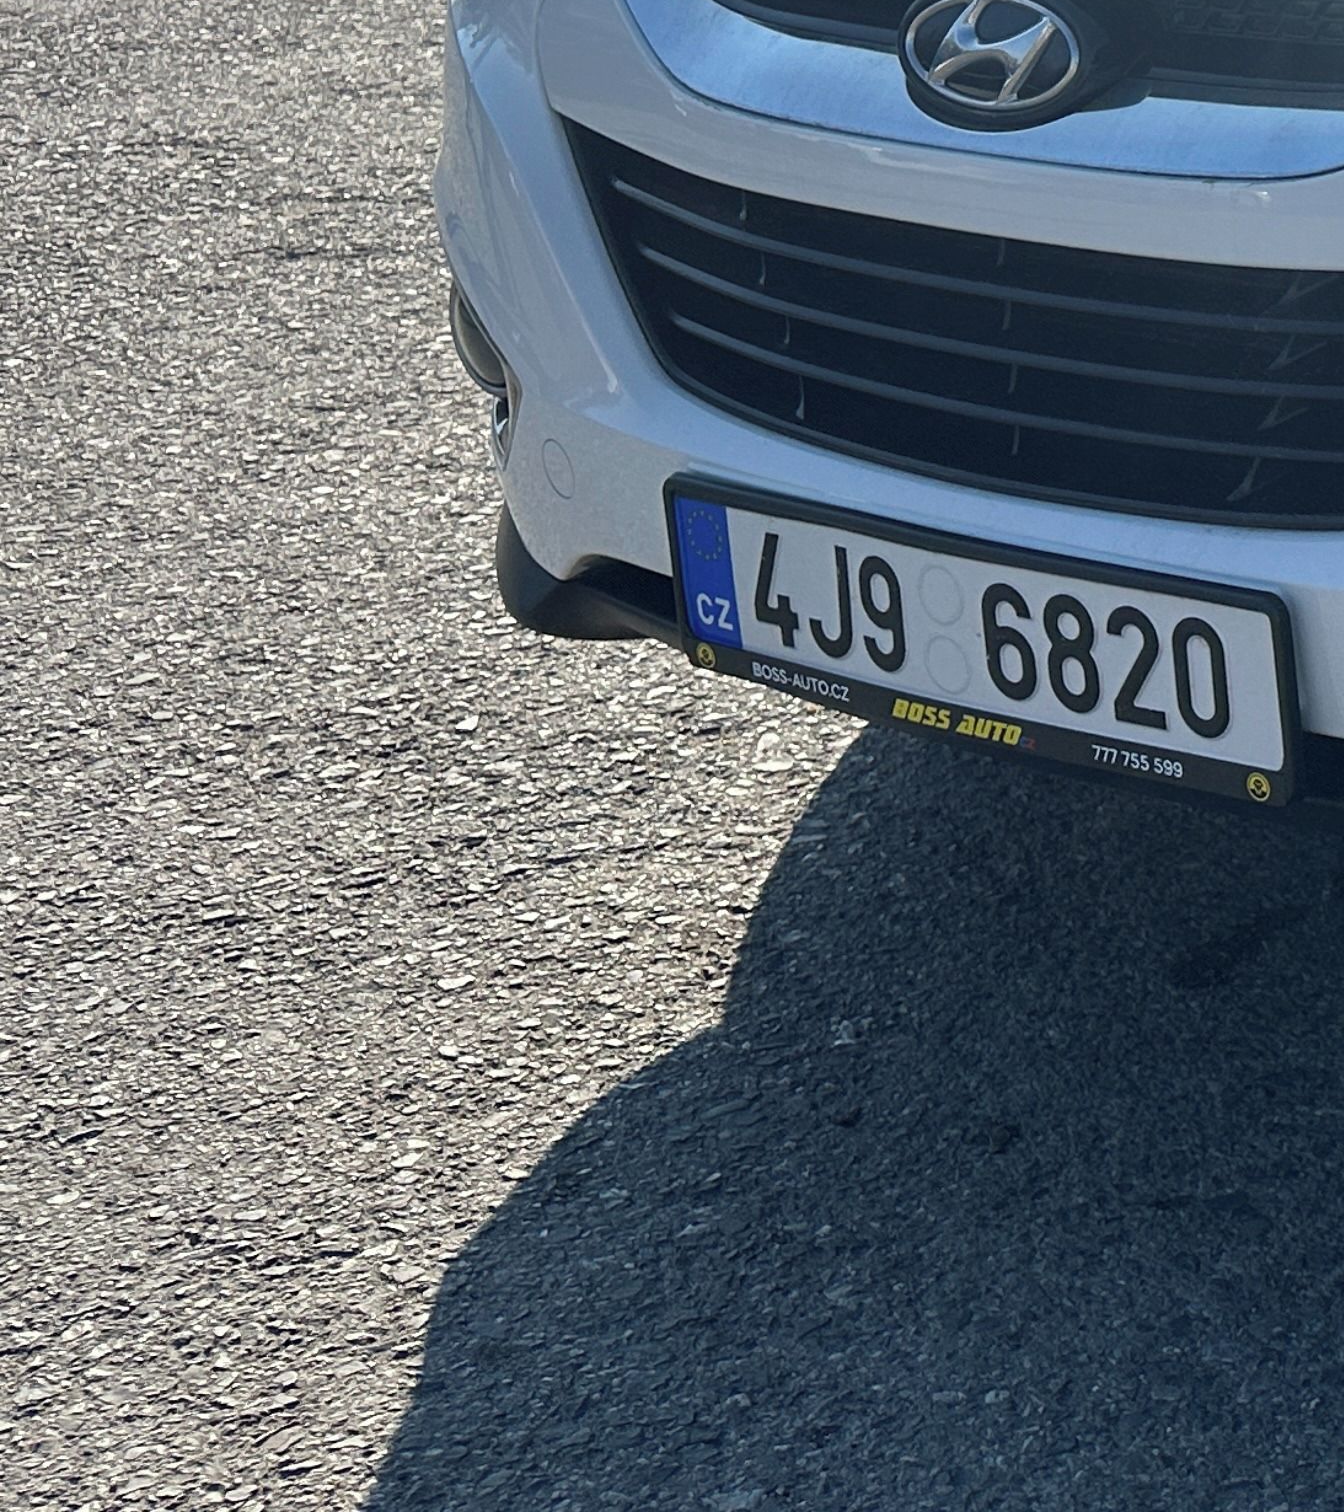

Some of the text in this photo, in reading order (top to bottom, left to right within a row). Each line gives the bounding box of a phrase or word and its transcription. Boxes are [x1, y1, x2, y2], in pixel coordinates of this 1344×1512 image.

[696, 532, 1230, 738] CZ 4J9 6820
[751, 661, 850, 702] BOSS-AUTO.CZ
[892, 698, 950, 730] BOSS
[955, 714, 1022, 746] AUTO
[1092, 744, 1183, 778] 777 755 599
